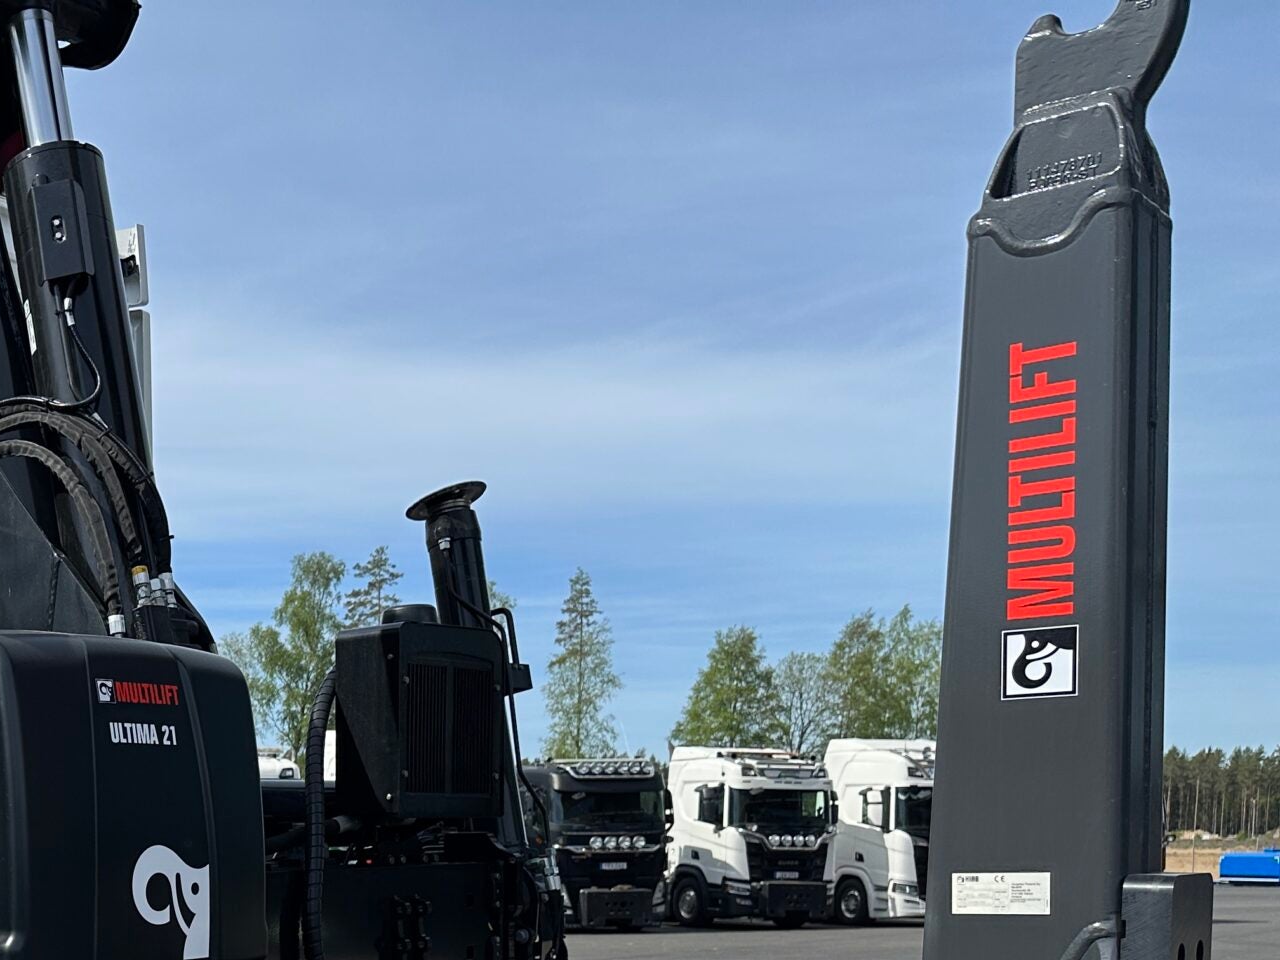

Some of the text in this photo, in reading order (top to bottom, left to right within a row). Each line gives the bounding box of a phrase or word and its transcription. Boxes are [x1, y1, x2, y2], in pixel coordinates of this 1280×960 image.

[1006, 341, 1078, 621] MULTILIFT
[115, 682, 179, 705] MULTILIFT
[109, 722, 177, 745] ULTIMA 21
